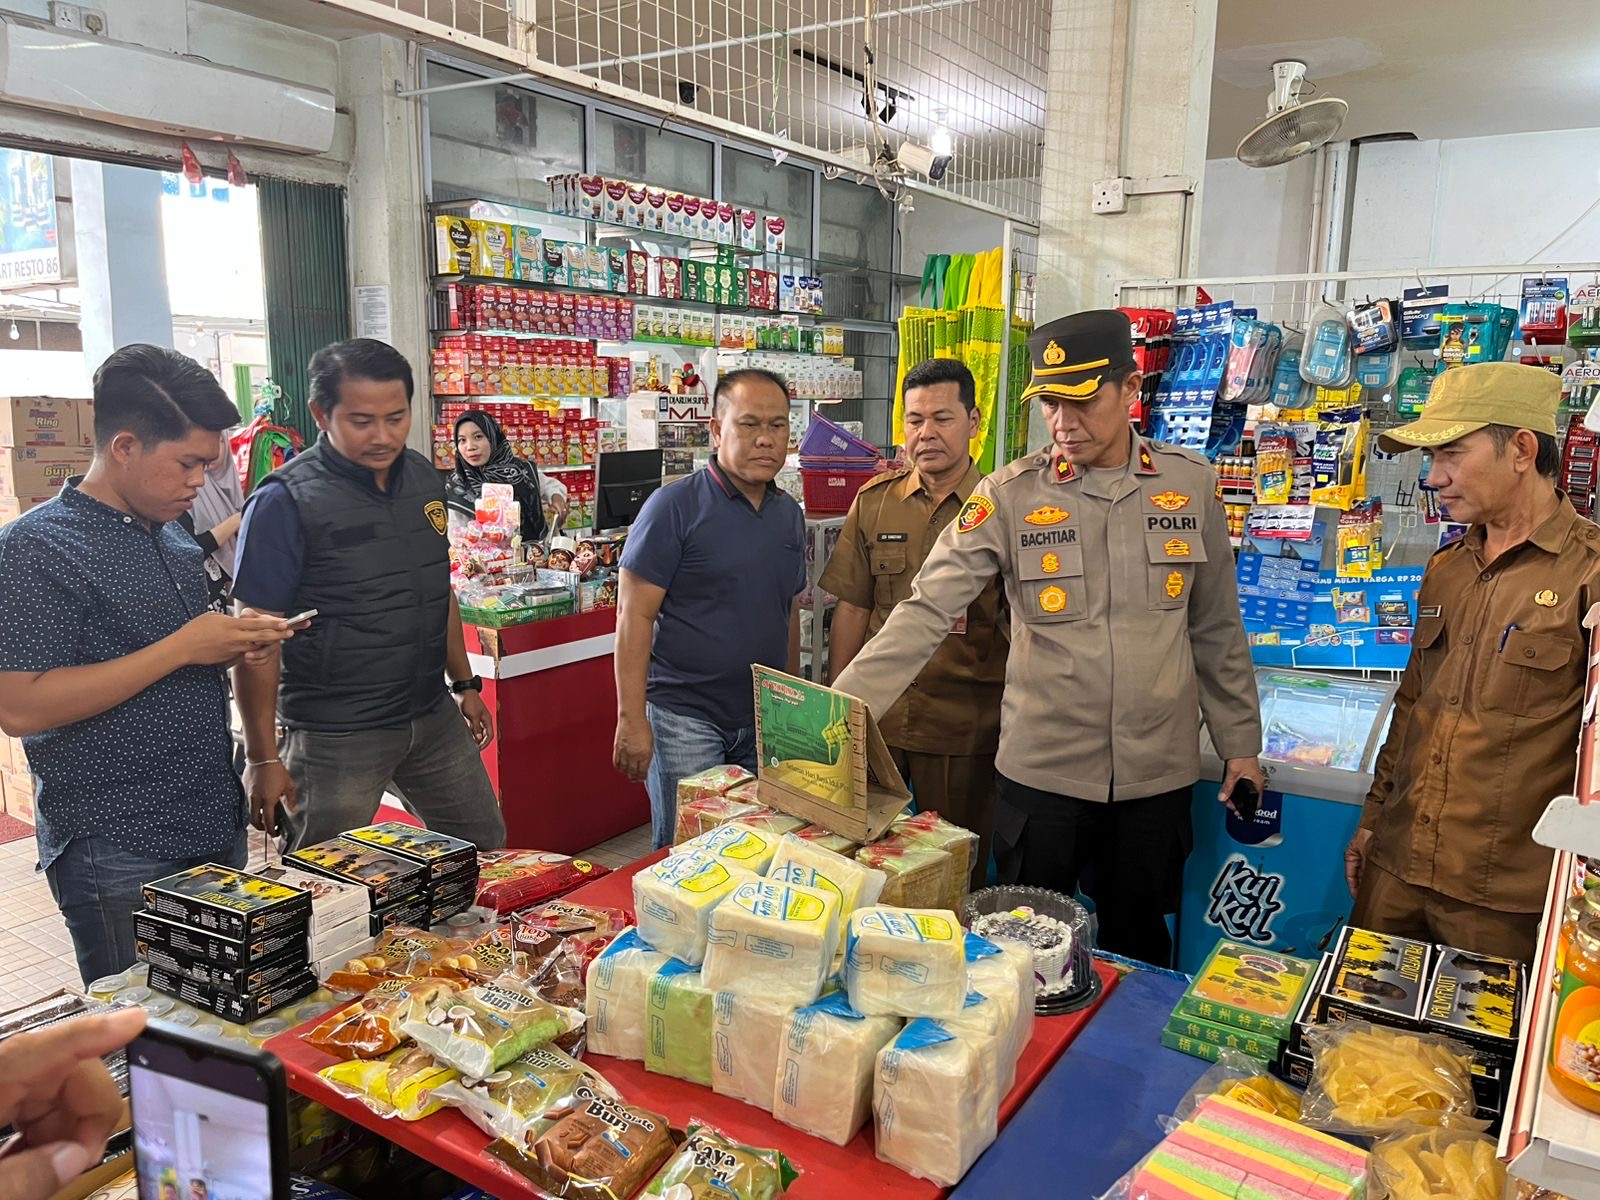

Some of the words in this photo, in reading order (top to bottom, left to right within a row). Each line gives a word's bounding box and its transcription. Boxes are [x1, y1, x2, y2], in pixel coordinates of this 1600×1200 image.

[0, 262, 12, 279] RT
[14, 259, 44, 278] RESTO
[46, 256, 58, 274] 86
[1148, 516, 1196, 530] POLRI
[1021, 529, 1076, 547] BACHTIAR
[1351, 550, 1367, 559] 5+1
[547, 904, 574, 913] Red
[480, 991, 512, 1010] Bun
[482, 982, 533, 1005] Coconut
[1187, 1022, 1258, 1053] 传统食品
[586, 1101, 628, 1133] Bun
[684, 1136, 736, 1167] Kaya
